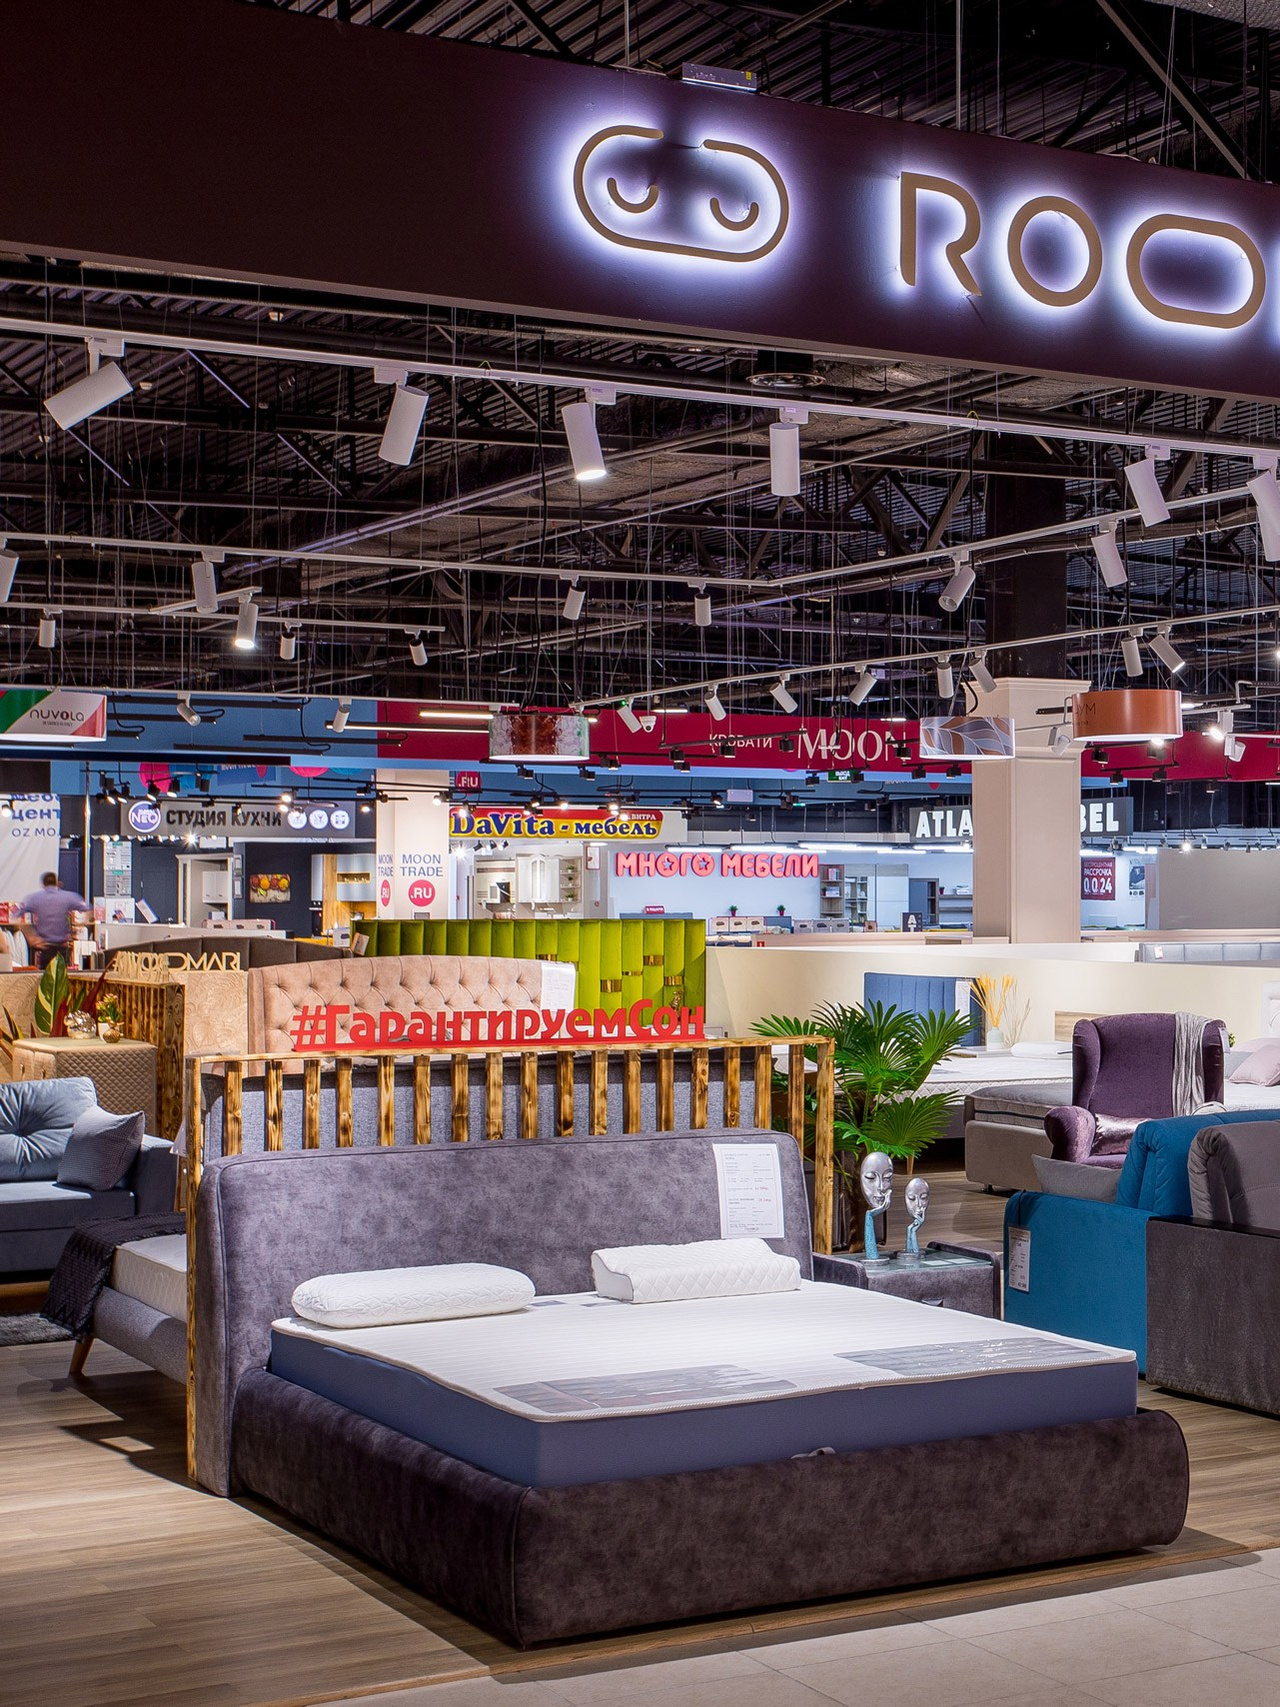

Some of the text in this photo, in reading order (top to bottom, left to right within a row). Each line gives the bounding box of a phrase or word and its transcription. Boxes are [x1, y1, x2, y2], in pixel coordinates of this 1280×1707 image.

[709, 733, 773, 749] КРОВАТИ
[166, 809, 282, 828] СТУДИЯ КУХНИ
[451, 811, 555, 836] DaVita
[574, 816, 658, 837] мебель
[378, 854, 393, 865] MOON
[402, 854, 441, 865] MOON
[615, 851, 820, 878] МНОГО МЕБЕЛИ
[378, 866, 394, 877] TRADE
[400, 866, 444, 877] TRADE
[289, 998, 705, 1050] #ГарантируемСон
